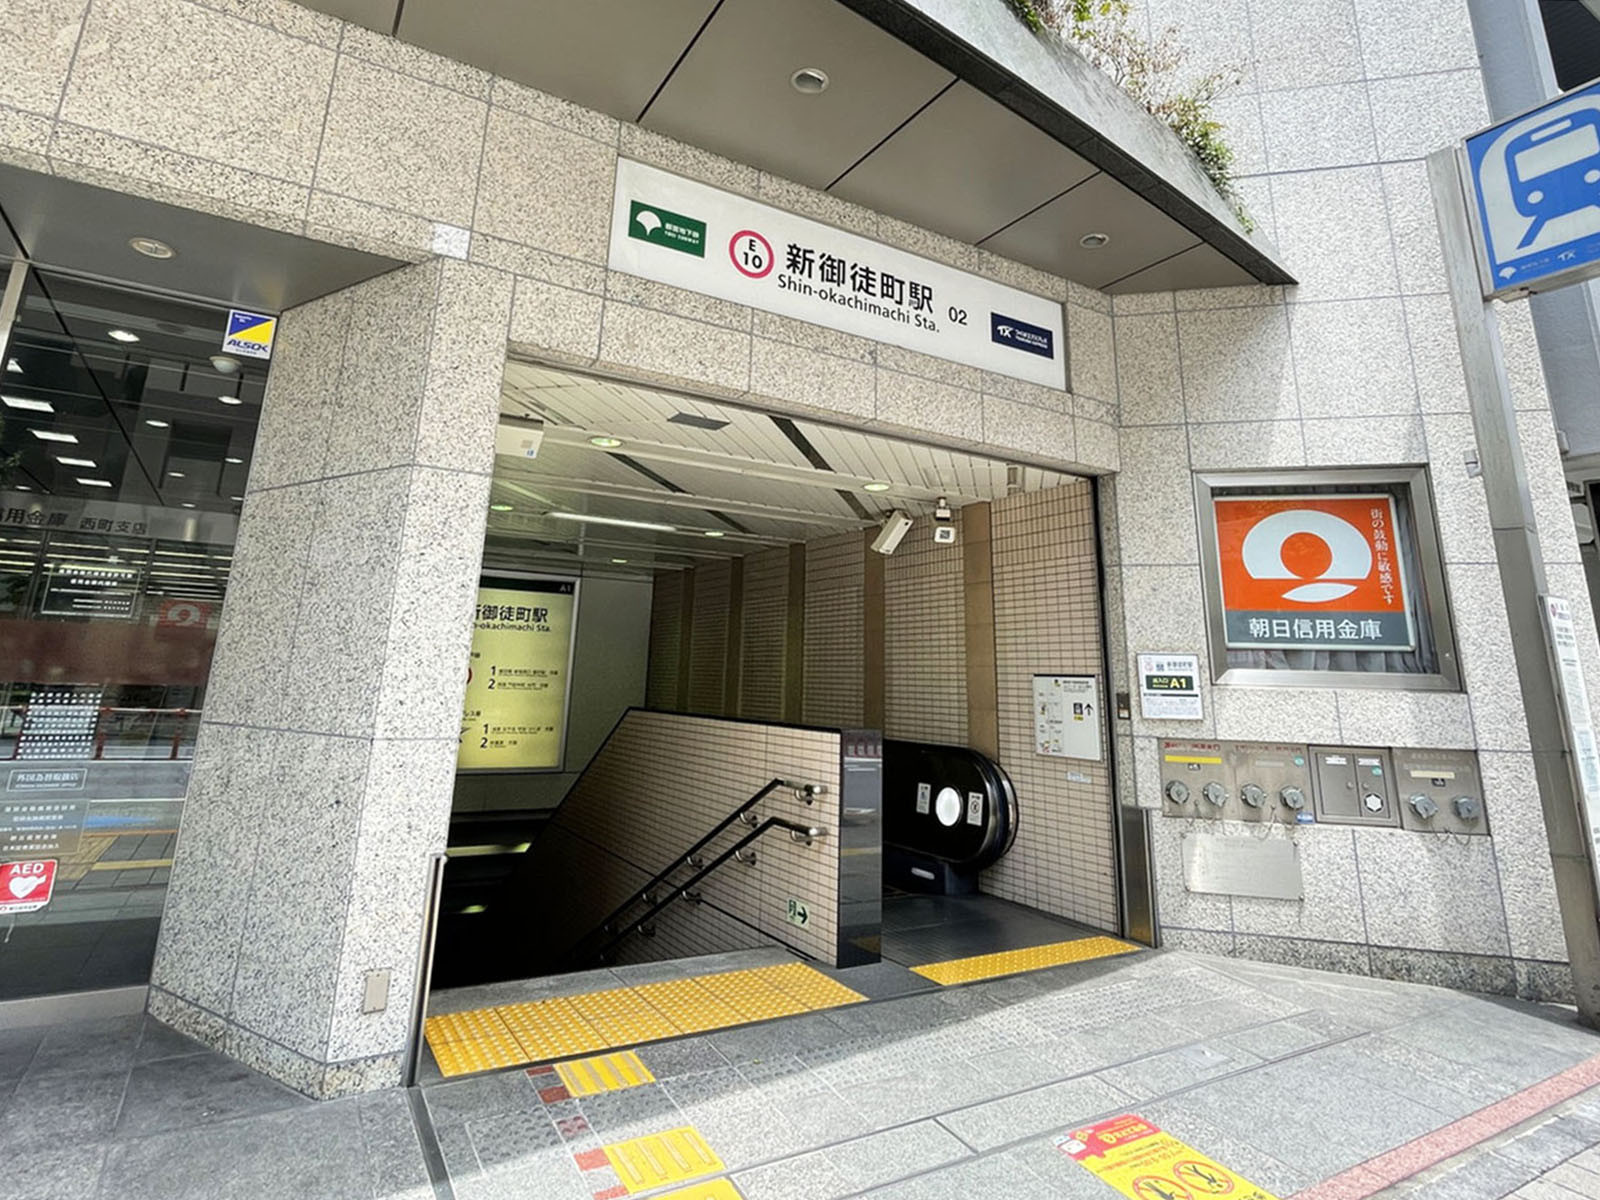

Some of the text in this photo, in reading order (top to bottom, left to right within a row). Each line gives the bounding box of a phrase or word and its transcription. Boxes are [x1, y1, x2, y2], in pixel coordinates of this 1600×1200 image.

[749, 239, 757, 252] E
[743, 251, 763, 269] 10
[786, 243, 934, 314] 新御徒町駅
[777, 273, 941, 333] Shin-okachimachi Sta.
[948, 306, 968, 326] 02
[227, 338, 268, 352] ALSOK
[79, 516, 148, 535] 西町支店
[1249, 618, 1383, 641] 朝日信用金庫
[490, 665, 496, 676] 1
[488, 678, 496, 690] 2
[1170, 677, 1187, 689] A1
[483, 723, 489, 735] 1
[480, 737, 488, 749] 2
[10, 862, 45, 875] AED
